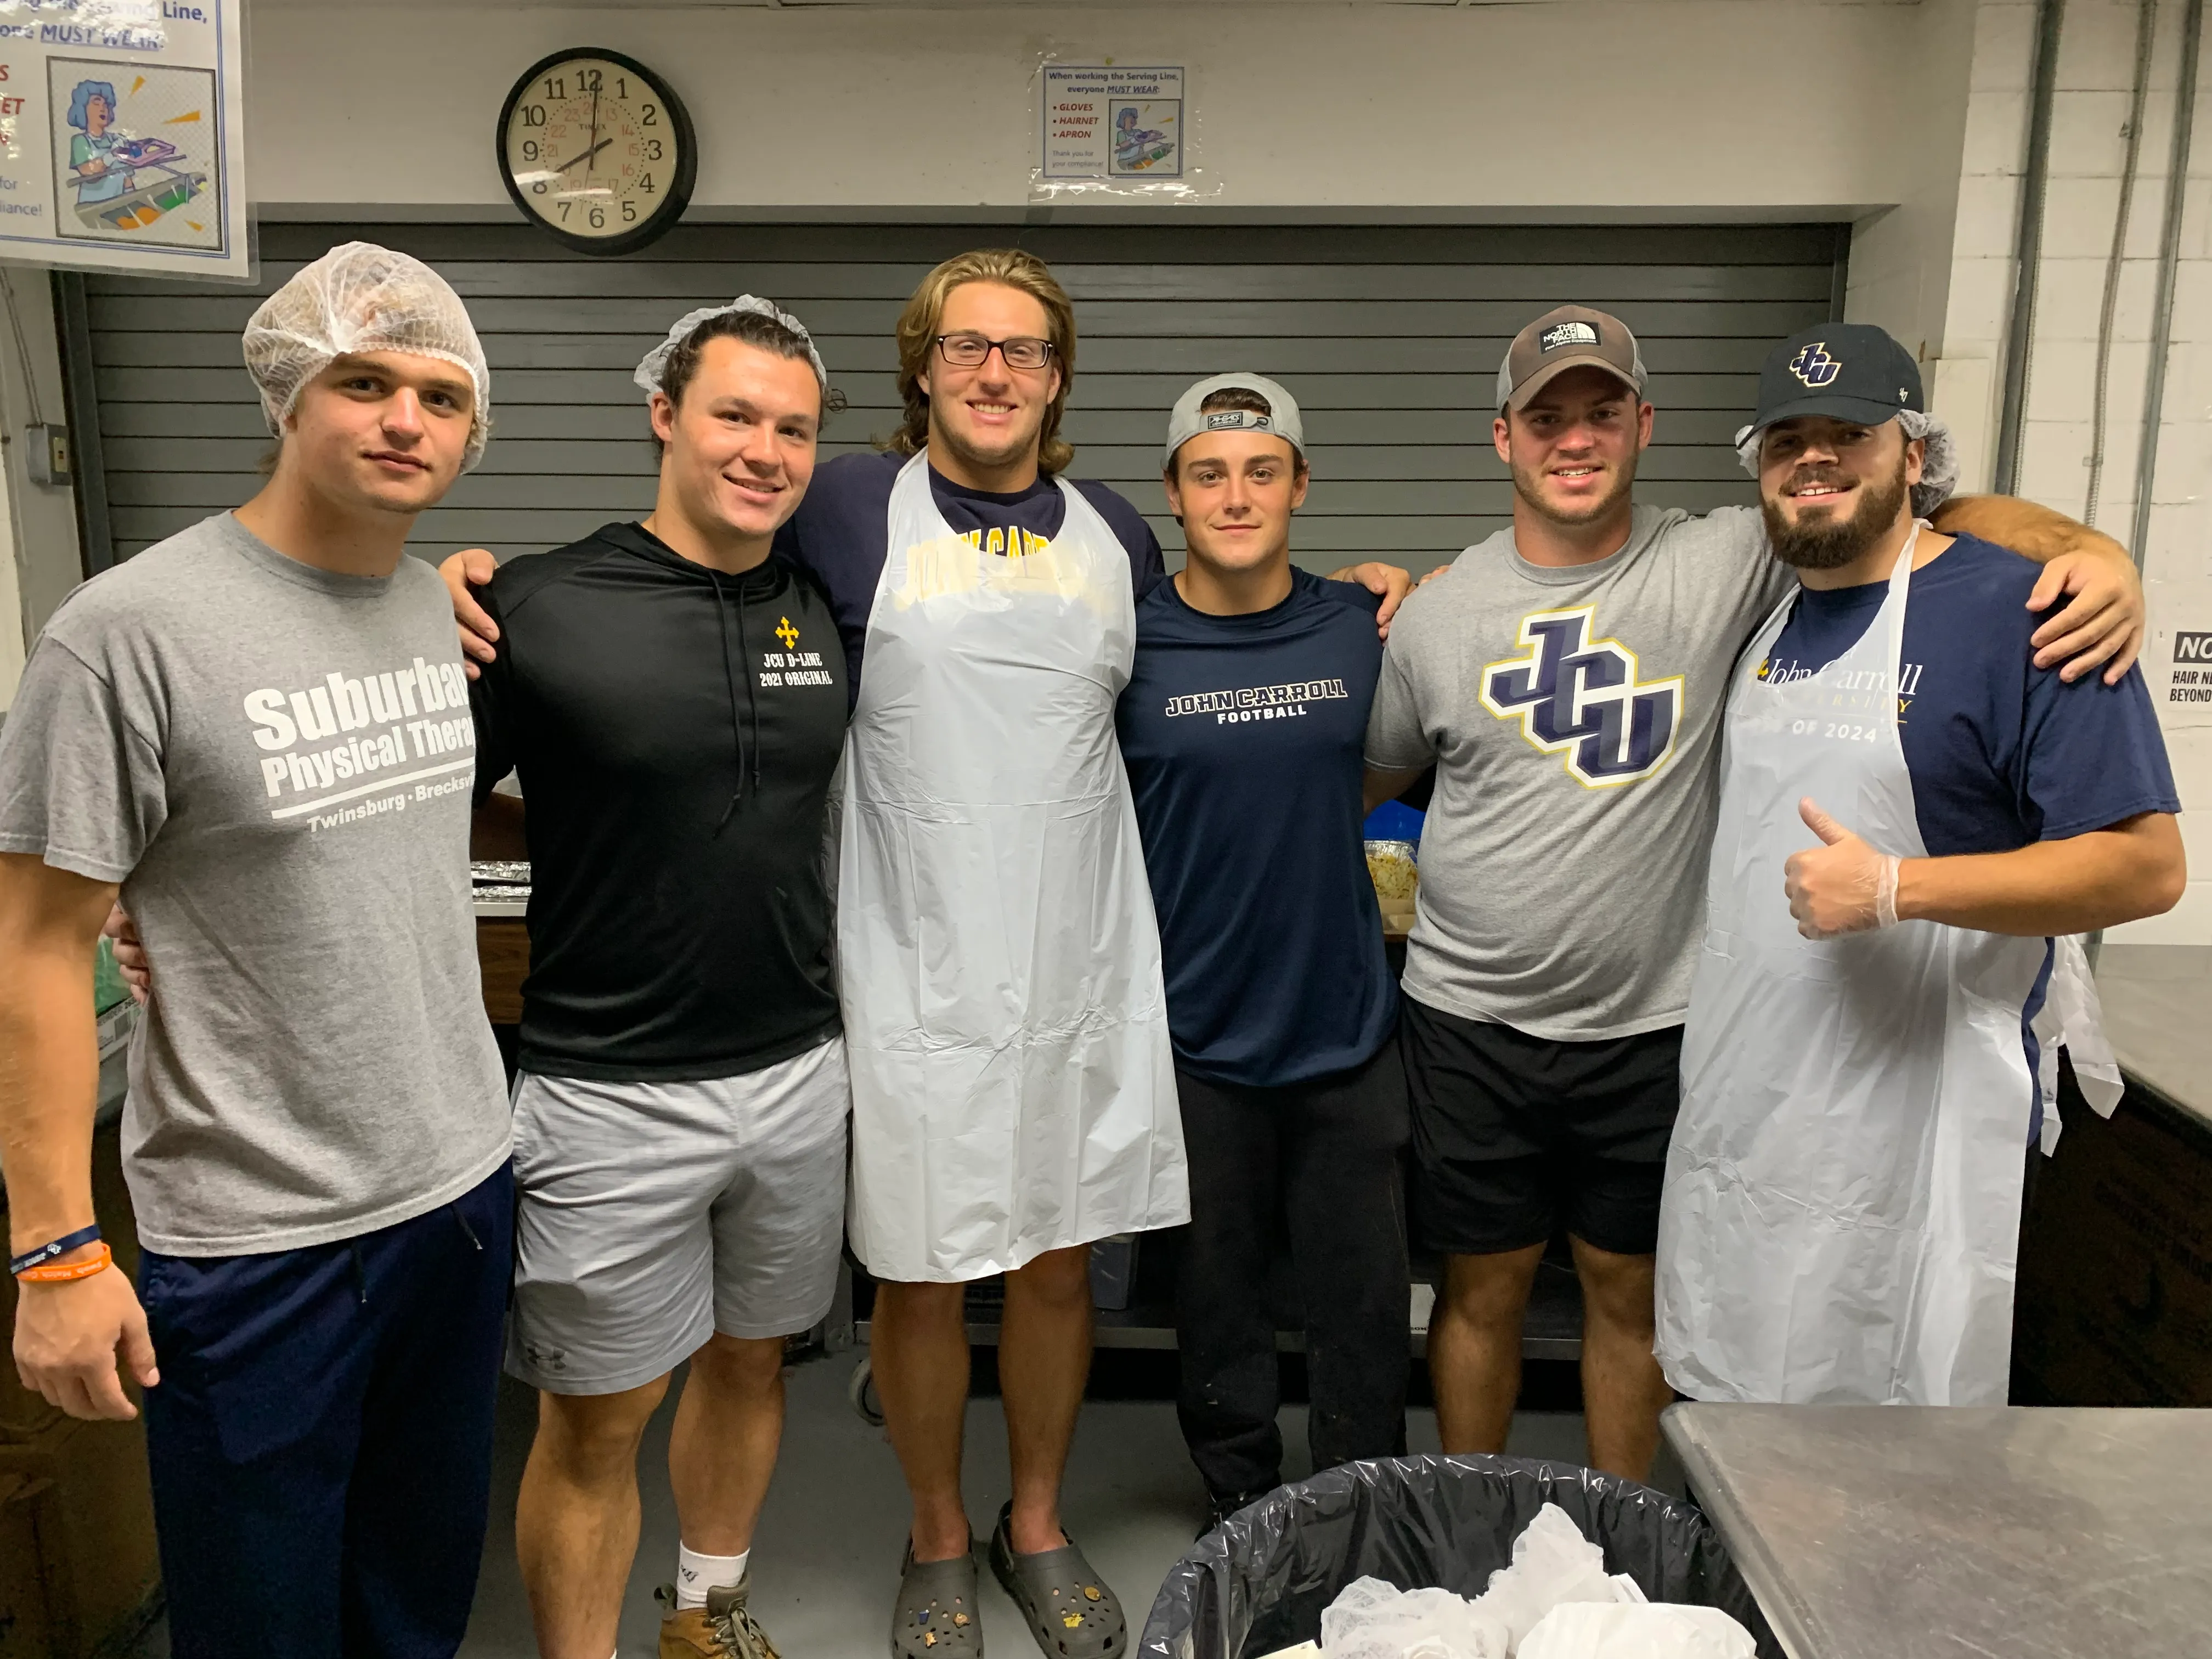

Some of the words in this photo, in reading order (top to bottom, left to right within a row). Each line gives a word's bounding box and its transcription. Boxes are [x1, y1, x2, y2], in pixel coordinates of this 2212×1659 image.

[41, 24, 96, 43] MUST
[576, 69, 603, 92] 12
[1075, 72, 1108, 82] working
[1126, 72, 1158, 82] Serving
[544, 78, 567, 99] 11
[616, 78, 629, 99] 1
[1107, 86, 1131, 94] MUST
[521, 105, 546, 127] 10
[642, 104, 657, 126] 2
[1059, 117, 1099, 125] HAIRNET
[550, 125, 567, 138] 22
[622, 124, 635, 137] 14
[522, 140, 539, 161] 9
[547, 145, 558, 157] 21
[629, 143, 640, 156] 15
[648, 139, 663, 161] 3
[622, 163, 635, 177] 16
[639, 173, 655, 193] 4
[557, 201, 572, 222] 7
[589, 208, 605, 228] 6
[622, 201, 636, 222] 5
[1543, 326, 1577, 343] NORTH
[1556, 322, 1576, 331] THE
[1552, 333, 1578, 344] FACE
[1789, 342, 1843, 388] JCU
[763, 653, 785, 668] JCU
[786, 652, 823, 668] D-LINE
[759, 672, 783, 687] 2021
[785, 670, 833, 686] ORIGINAL
[1766, 658, 1812, 684] John
[2172, 671, 2199, 684] HAIR
[1165, 691, 1235, 717] JOHN
[1236, 679, 1348, 708] CARROLL
[1478, 602, 1685, 789] JCU
[2170, 689, 2212, 702] BEYOND
[1217, 704, 1307, 725] FOOTBALL
[1824, 723, 1877, 743] 2024
[260, 725, 407, 798] Physical
[306, 794, 406, 833] Twinsburg
